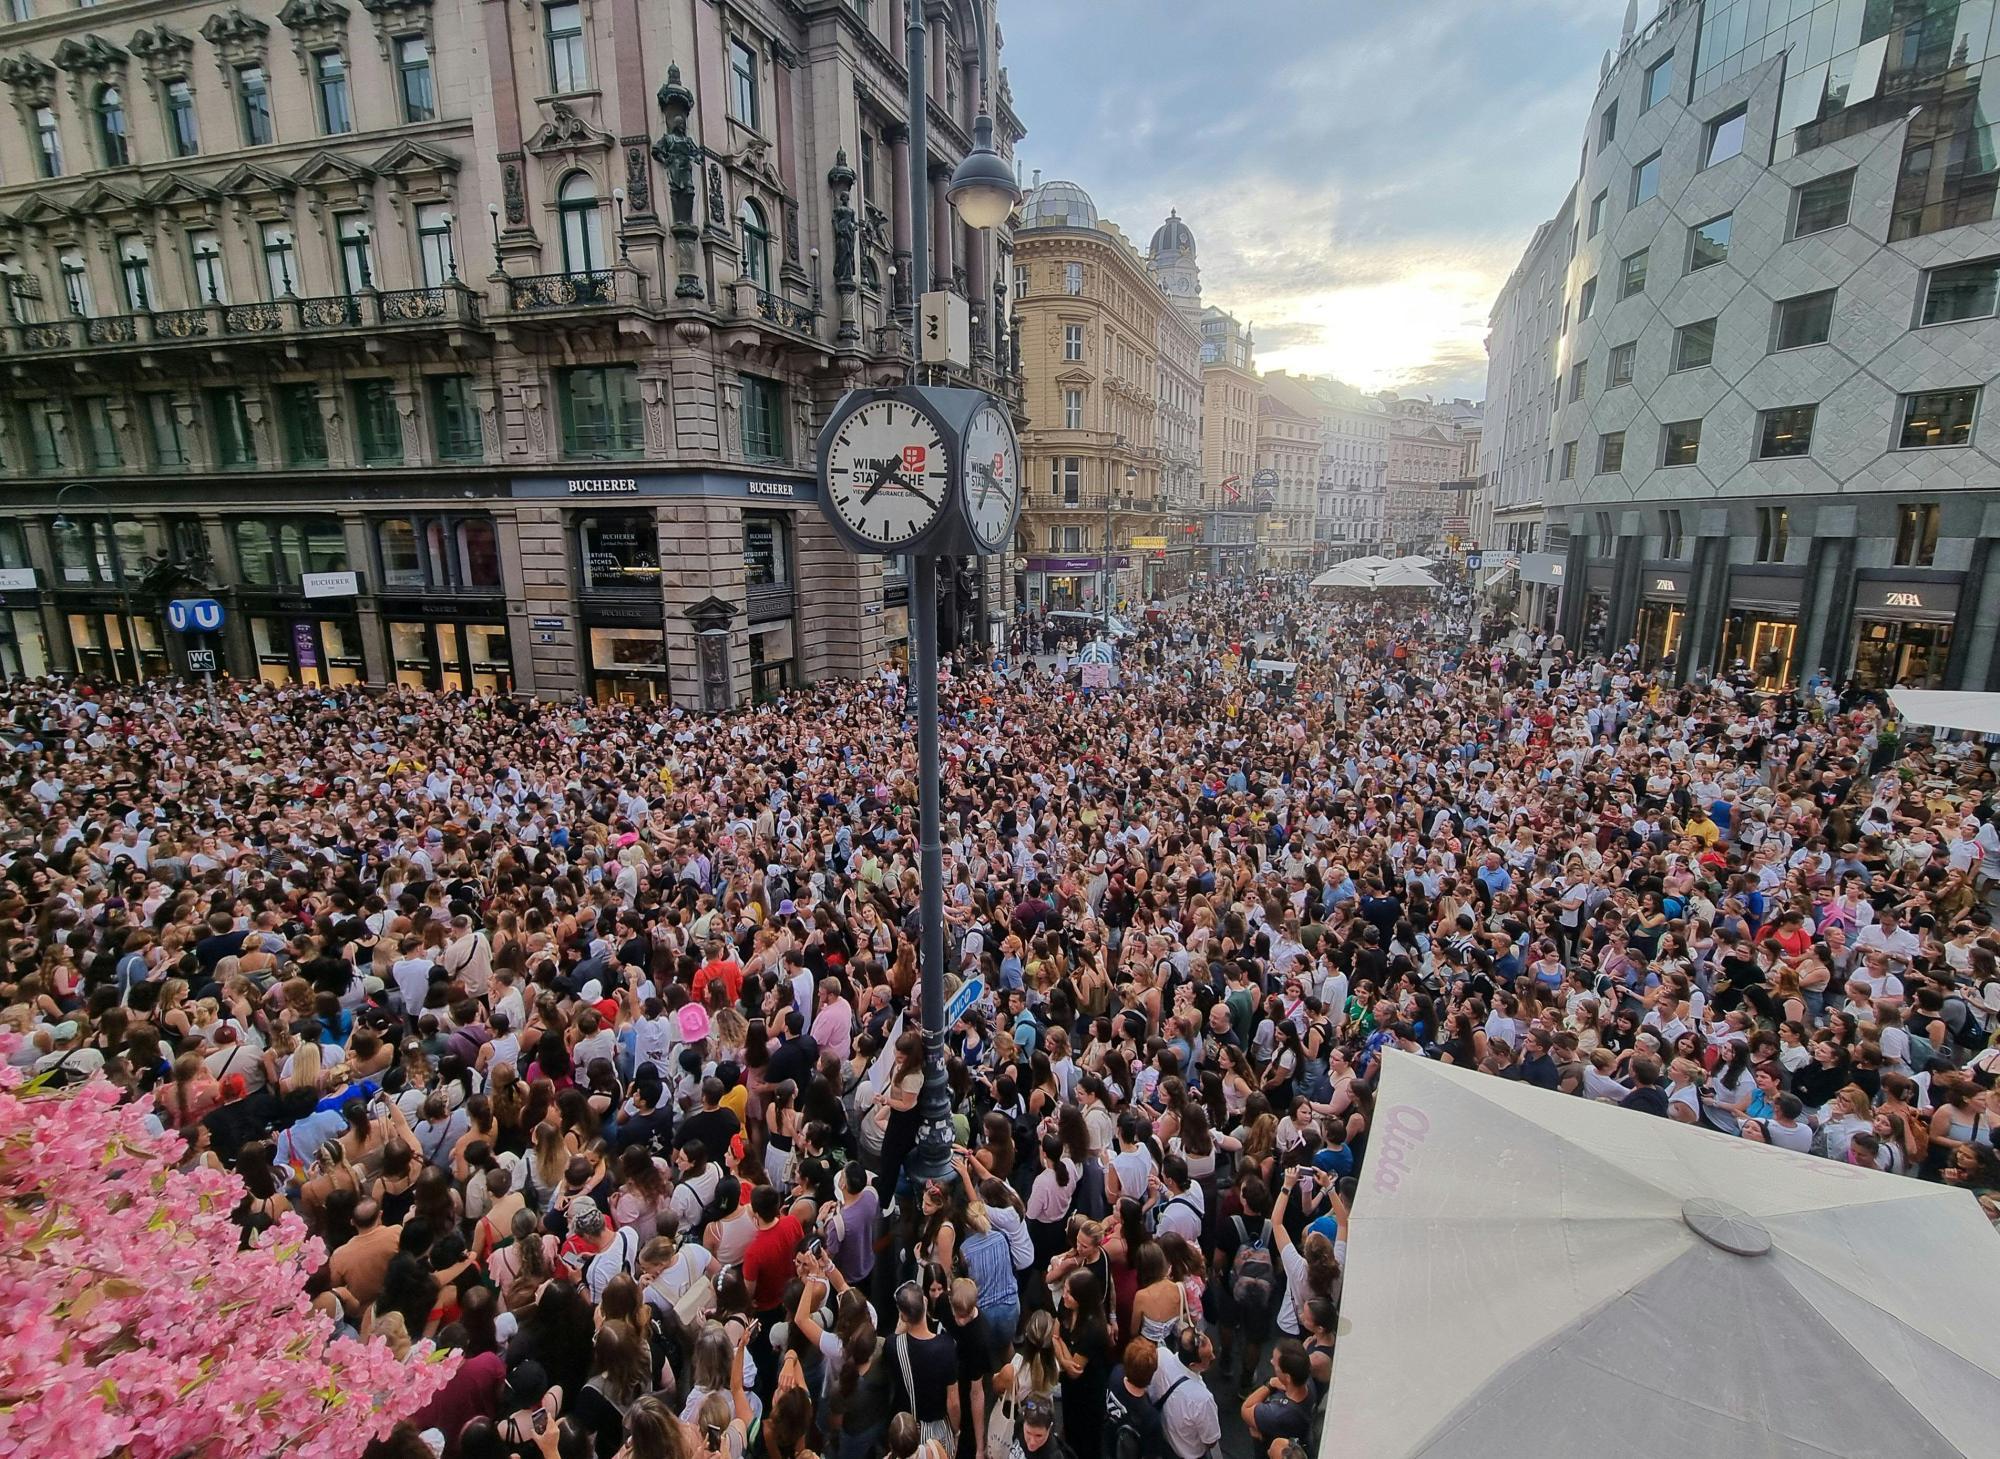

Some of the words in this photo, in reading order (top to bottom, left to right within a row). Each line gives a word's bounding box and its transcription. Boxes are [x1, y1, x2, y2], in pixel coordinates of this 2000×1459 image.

[568, 479, 637, 493] BUCHERER
[749, 482, 794, 496] BUCHERER
[311, 578, 351, 587] BUCHERER
[1656, 579, 1676, 591] ZARA
[1886, 592, 1923, 607] ZARA
[168, 606, 186, 629] U
[195, 605, 220, 628] U
[190, 652, 212, 662] WC
